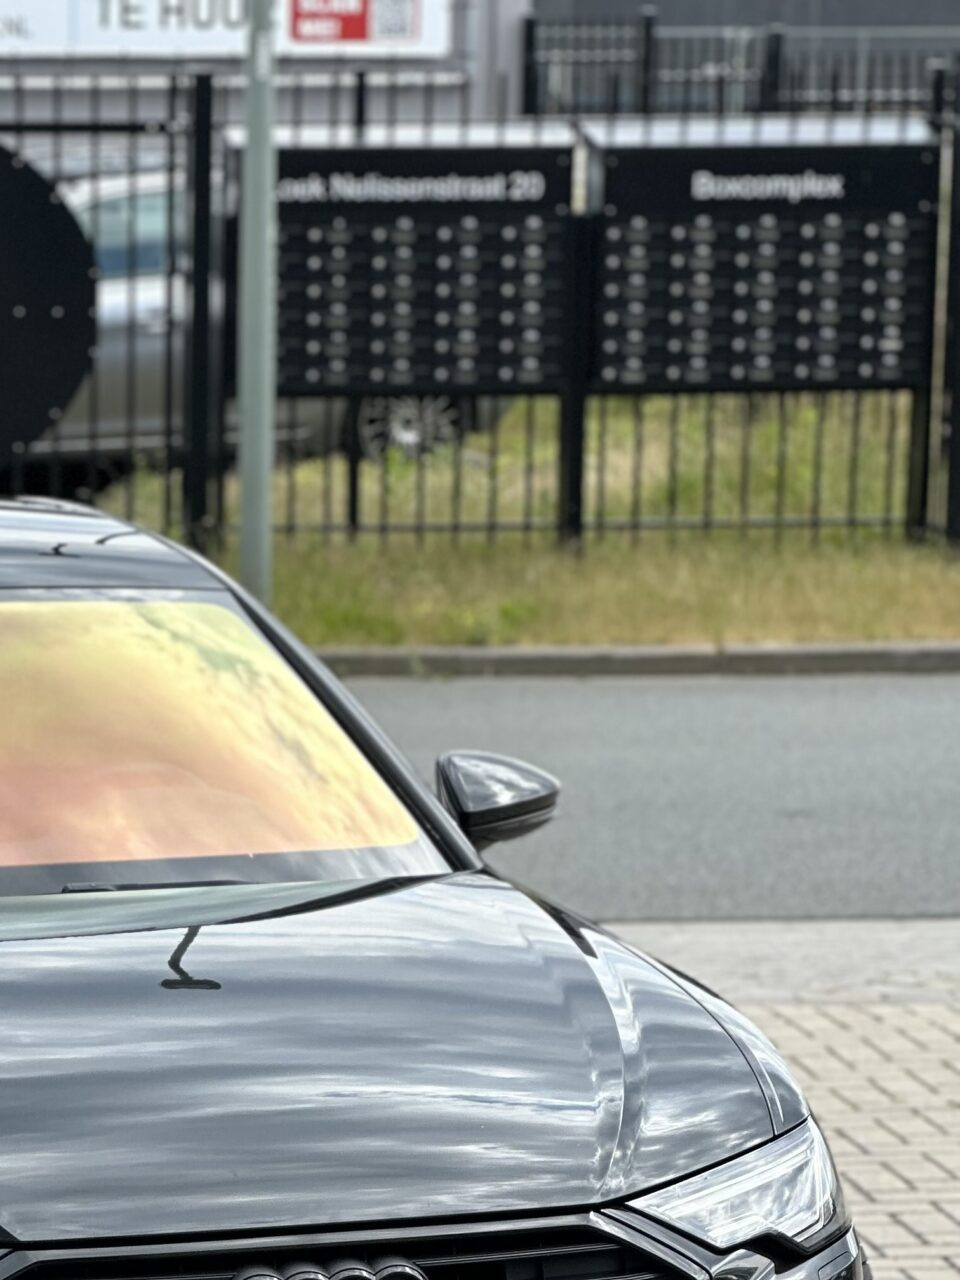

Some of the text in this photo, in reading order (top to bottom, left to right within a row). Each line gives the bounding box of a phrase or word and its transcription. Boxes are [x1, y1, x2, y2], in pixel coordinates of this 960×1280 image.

[330, 172, 505, 201] Nelissenstraat
[508, 171, 544, 200] 20
[692, 170, 844, 203] Boxcomplex
